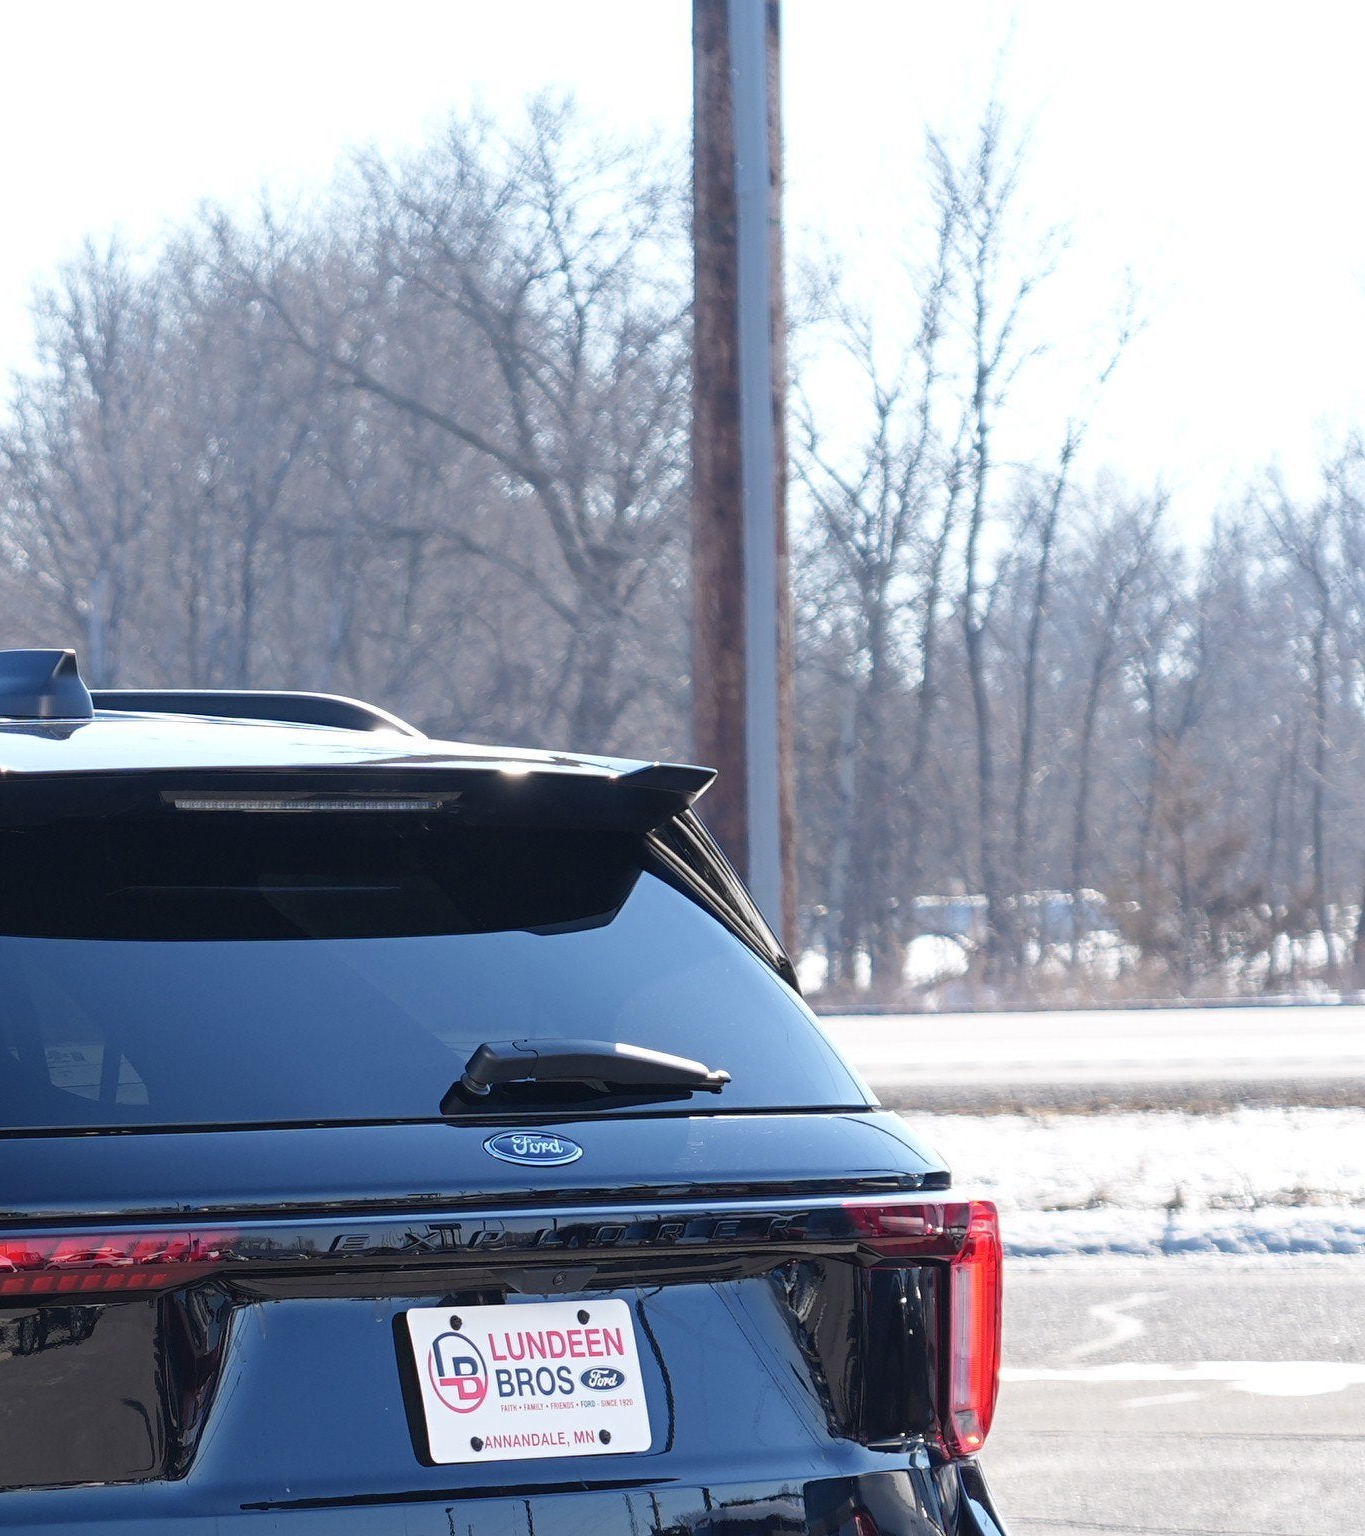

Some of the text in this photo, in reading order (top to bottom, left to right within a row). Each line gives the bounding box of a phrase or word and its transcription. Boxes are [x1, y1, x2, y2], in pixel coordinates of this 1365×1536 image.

[511, 1135, 564, 1155] Ford
[329, 1218, 791, 1251] EXPLORER
[488, 1328, 624, 1361] LUNDEEN
[495, 1366, 575, 1398] BROS
[588, 1370, 618, 1387] Ford
[501, 1404, 518, 1412] FAITH
[523, 1403, 544, 1411] FAMILY
[550, 1401, 575, 1410] FRIENDS
[580, 1400, 596, 1408] FORD
[600, 1399, 617, 1407] SINCE
[484, 1430, 595, 1448] ANNANDALE, MN
